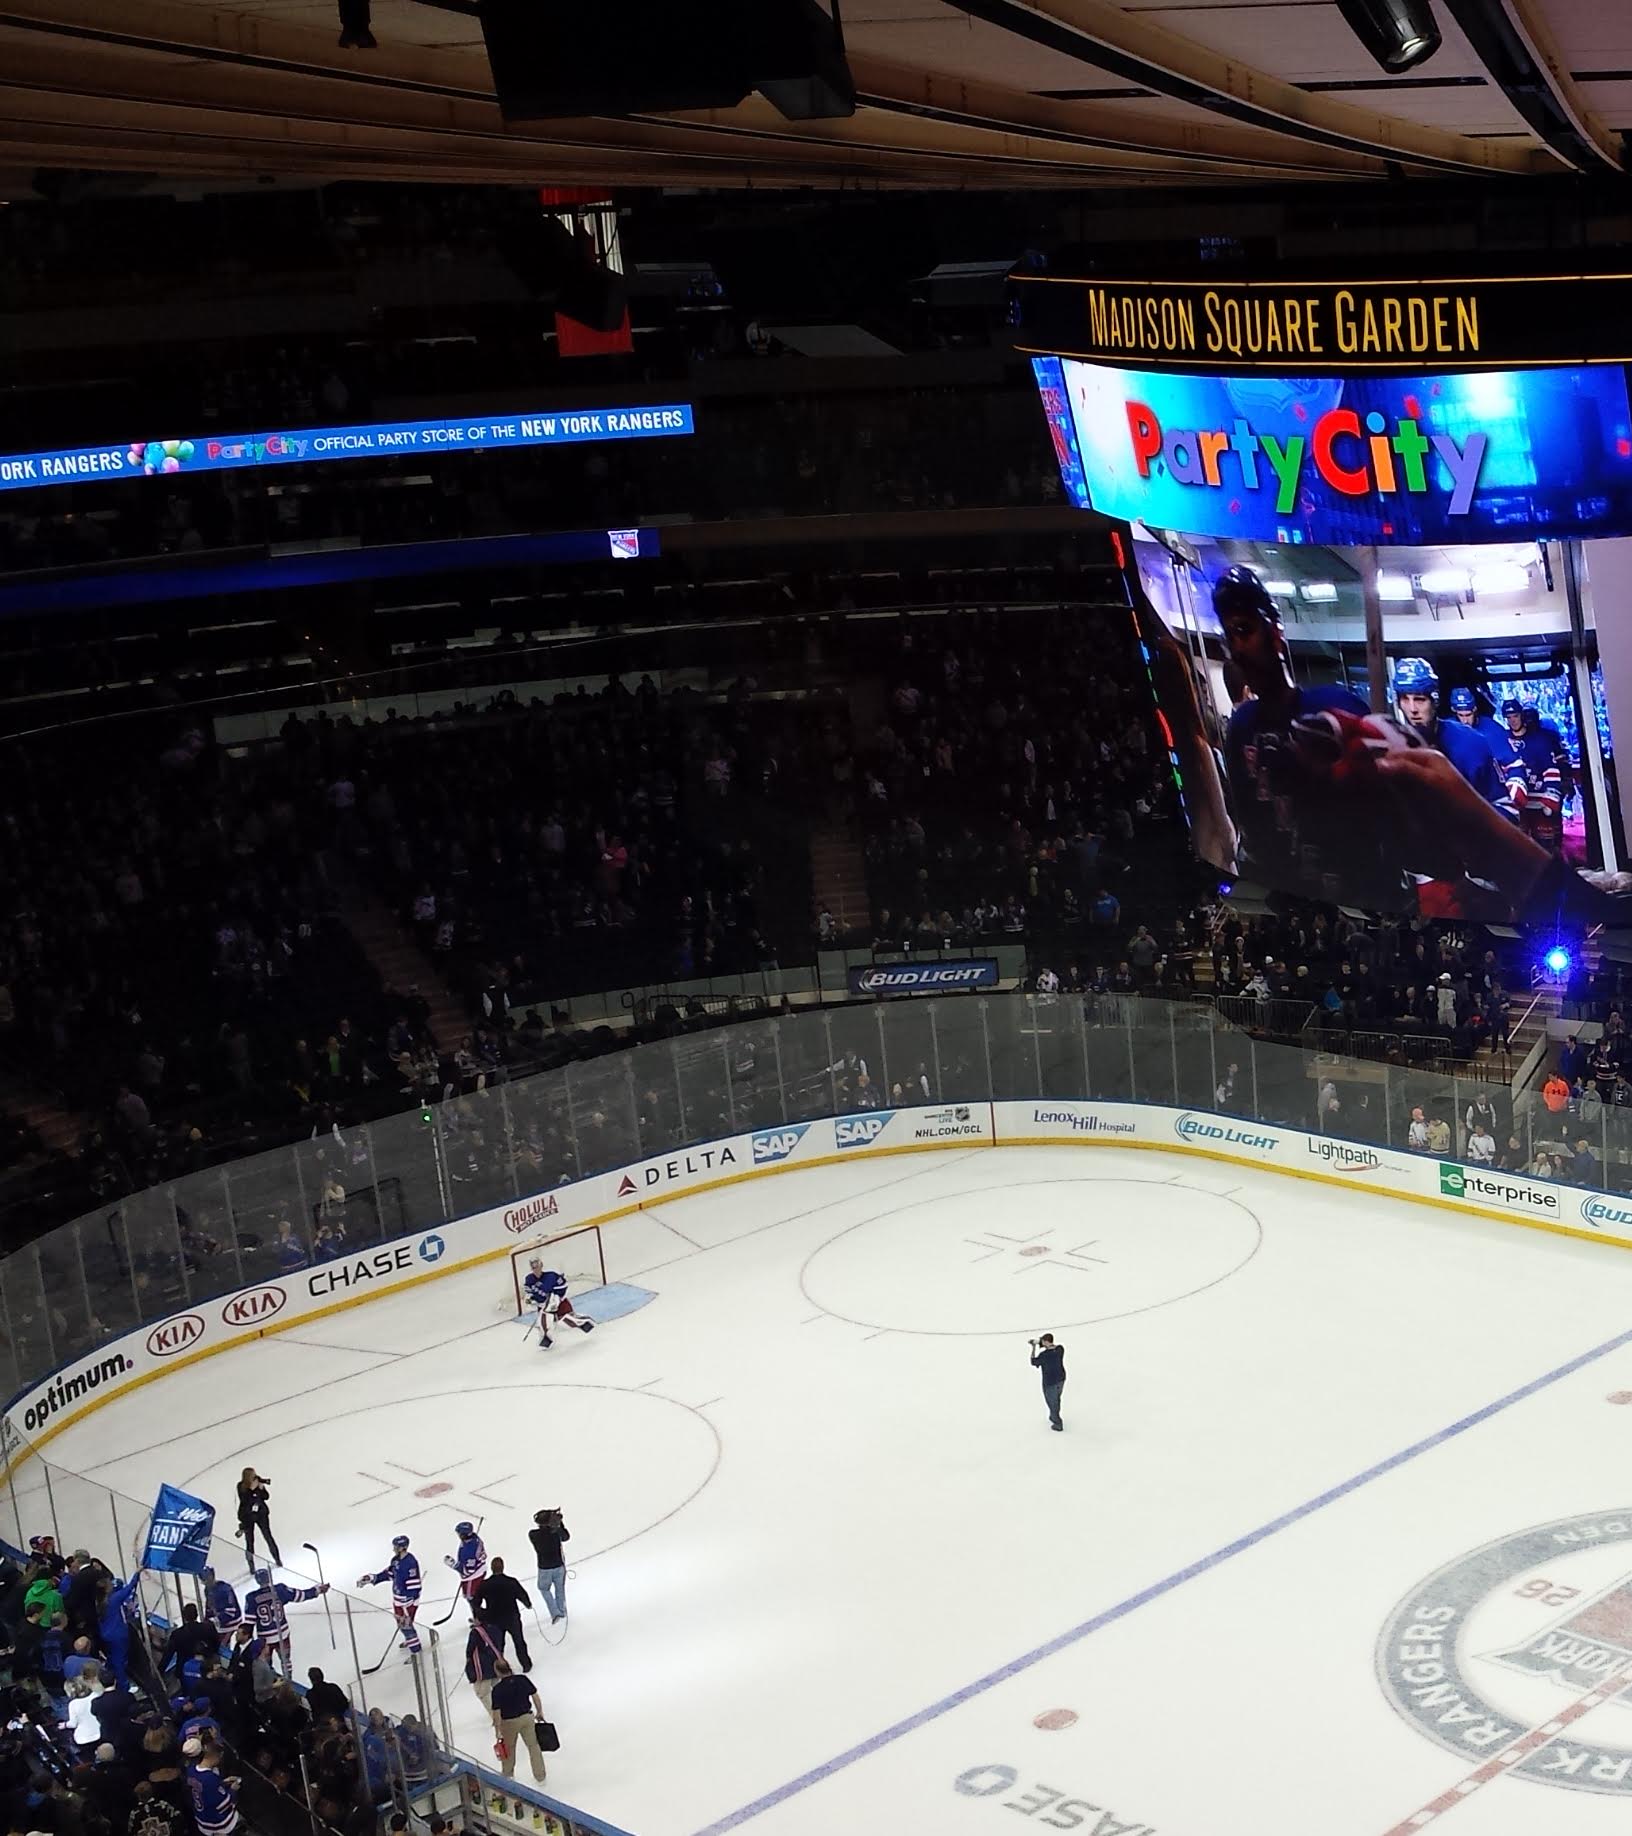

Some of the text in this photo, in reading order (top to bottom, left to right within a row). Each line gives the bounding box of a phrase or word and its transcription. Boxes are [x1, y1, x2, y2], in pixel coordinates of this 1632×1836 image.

[1089, 289, 1480, 357] MADISON SQUARE GARDEN
[0, 459, 37, 482] ORK
[41, 451, 124, 478] RANGERS
[313, 434, 374, 452] OFFICIAL
[378, 431, 418, 447] PARTY
[422, 427, 464, 443] STORE
[467, 426, 488, 440] OF
[490, 424, 516, 438] THE
[520, 417, 557, 438] NEW
[560, 415, 602, 435] YORK
[607, 410, 684, 432] RANGERS
[869, 968, 986, 986] BUD LIGHT
[836, 1119, 883, 1143] SAP
[915, 1125, 982, 1138] NHL.COM/GCL
[1033, 1109, 1135, 1134] Lenox Hill Hospital
[1182, 1120, 1280, 1151] BUD LIGHT
[753, 1132, 799, 1159] SAP
[1308, 1137, 1379, 1166] Lightpath
[645, 1146, 737, 1186] DELTA
[1441, 1166, 1558, 1210] enterprise
[504, 1194, 558, 1232] CHOLULA
[308, 1245, 414, 1297] CHASE
[231, 1290, 278, 1321] KIA
[155, 1319, 195, 1352] KIA
[1513, 1578, 1582, 1607] 26
[1400, 1606, 1513, 1746] RANGERS
[1003, 1783, 1157, 1836] ASE
